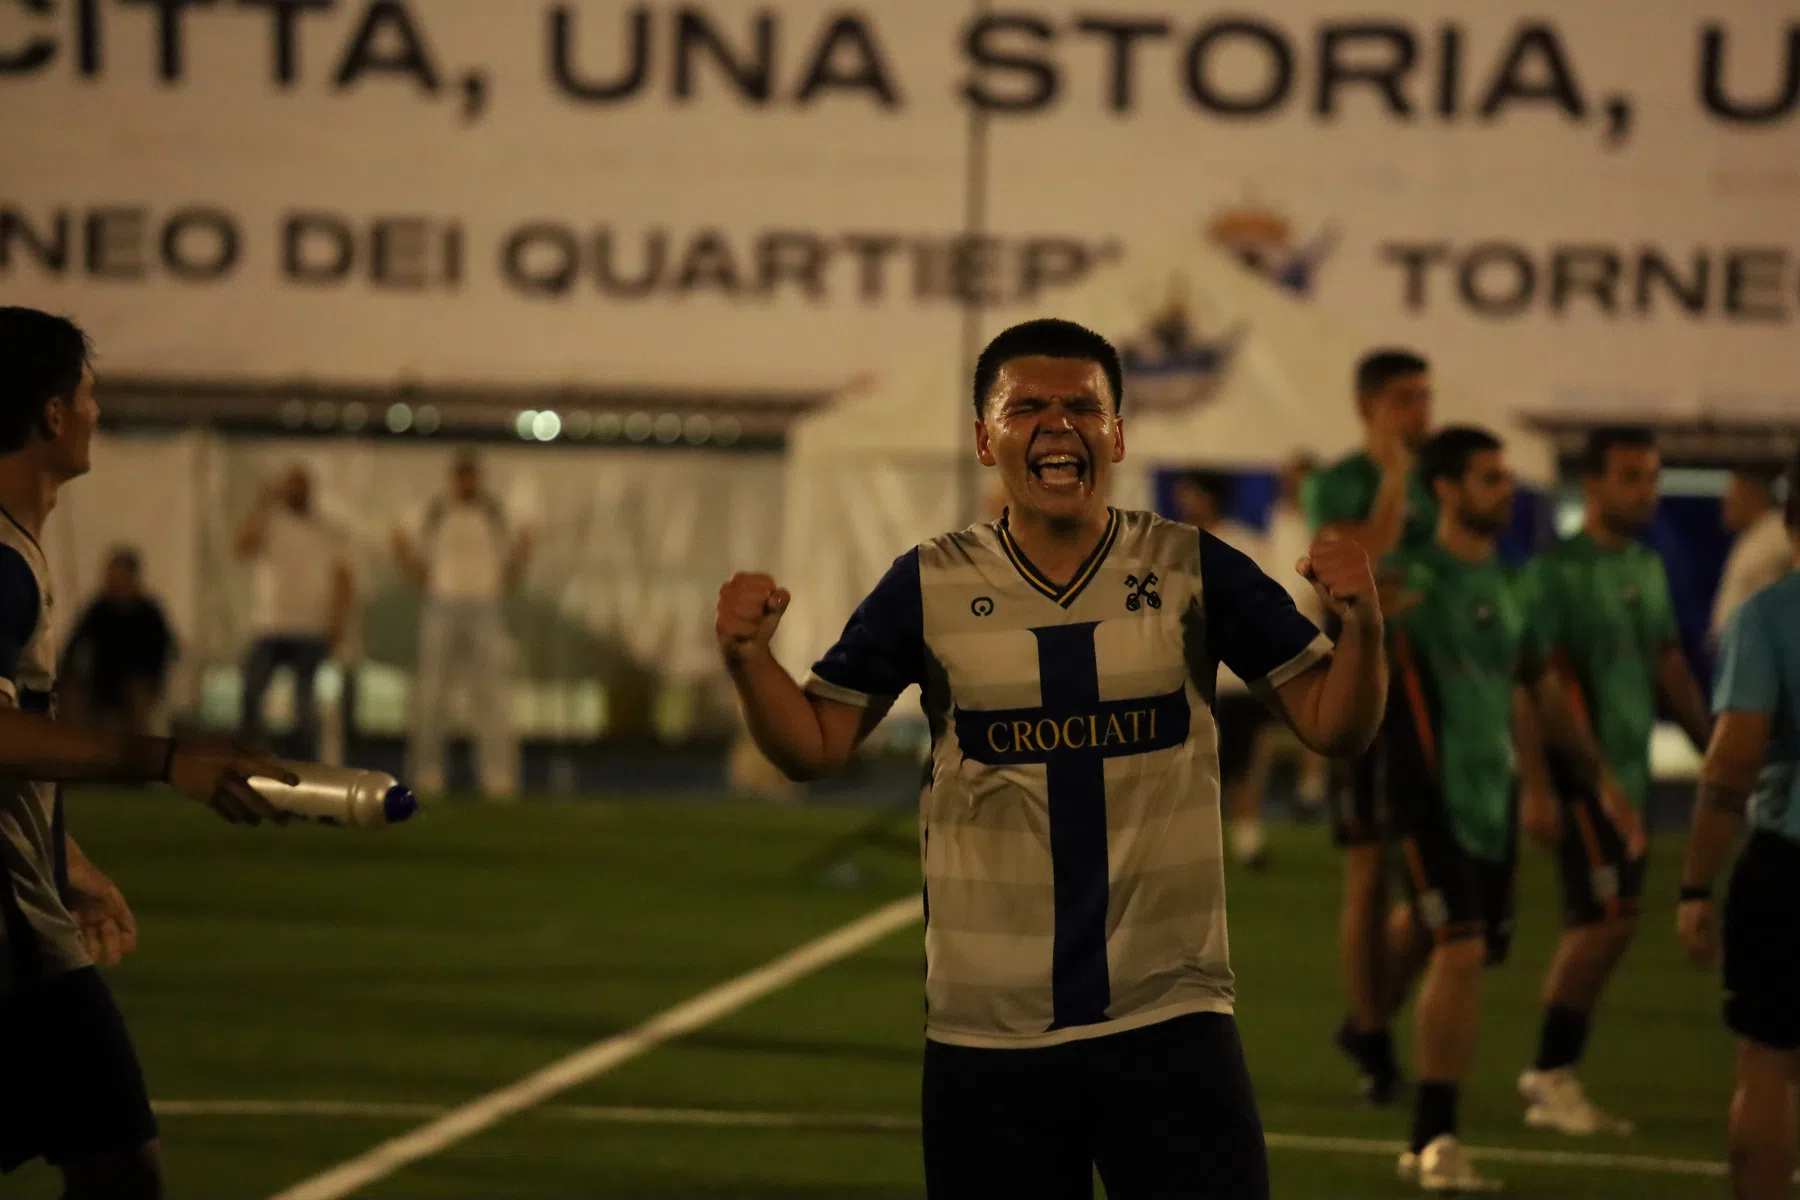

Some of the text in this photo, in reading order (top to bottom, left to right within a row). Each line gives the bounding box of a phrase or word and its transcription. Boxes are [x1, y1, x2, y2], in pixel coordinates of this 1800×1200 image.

[549, 4, 900, 109] UNA
[962, 14, 1632, 143] STORIA,
[281, 212, 464, 286] DEI
[1382, 241, 1800, 322] TORNE
[987, 708, 1157, 753] CROCIATI
